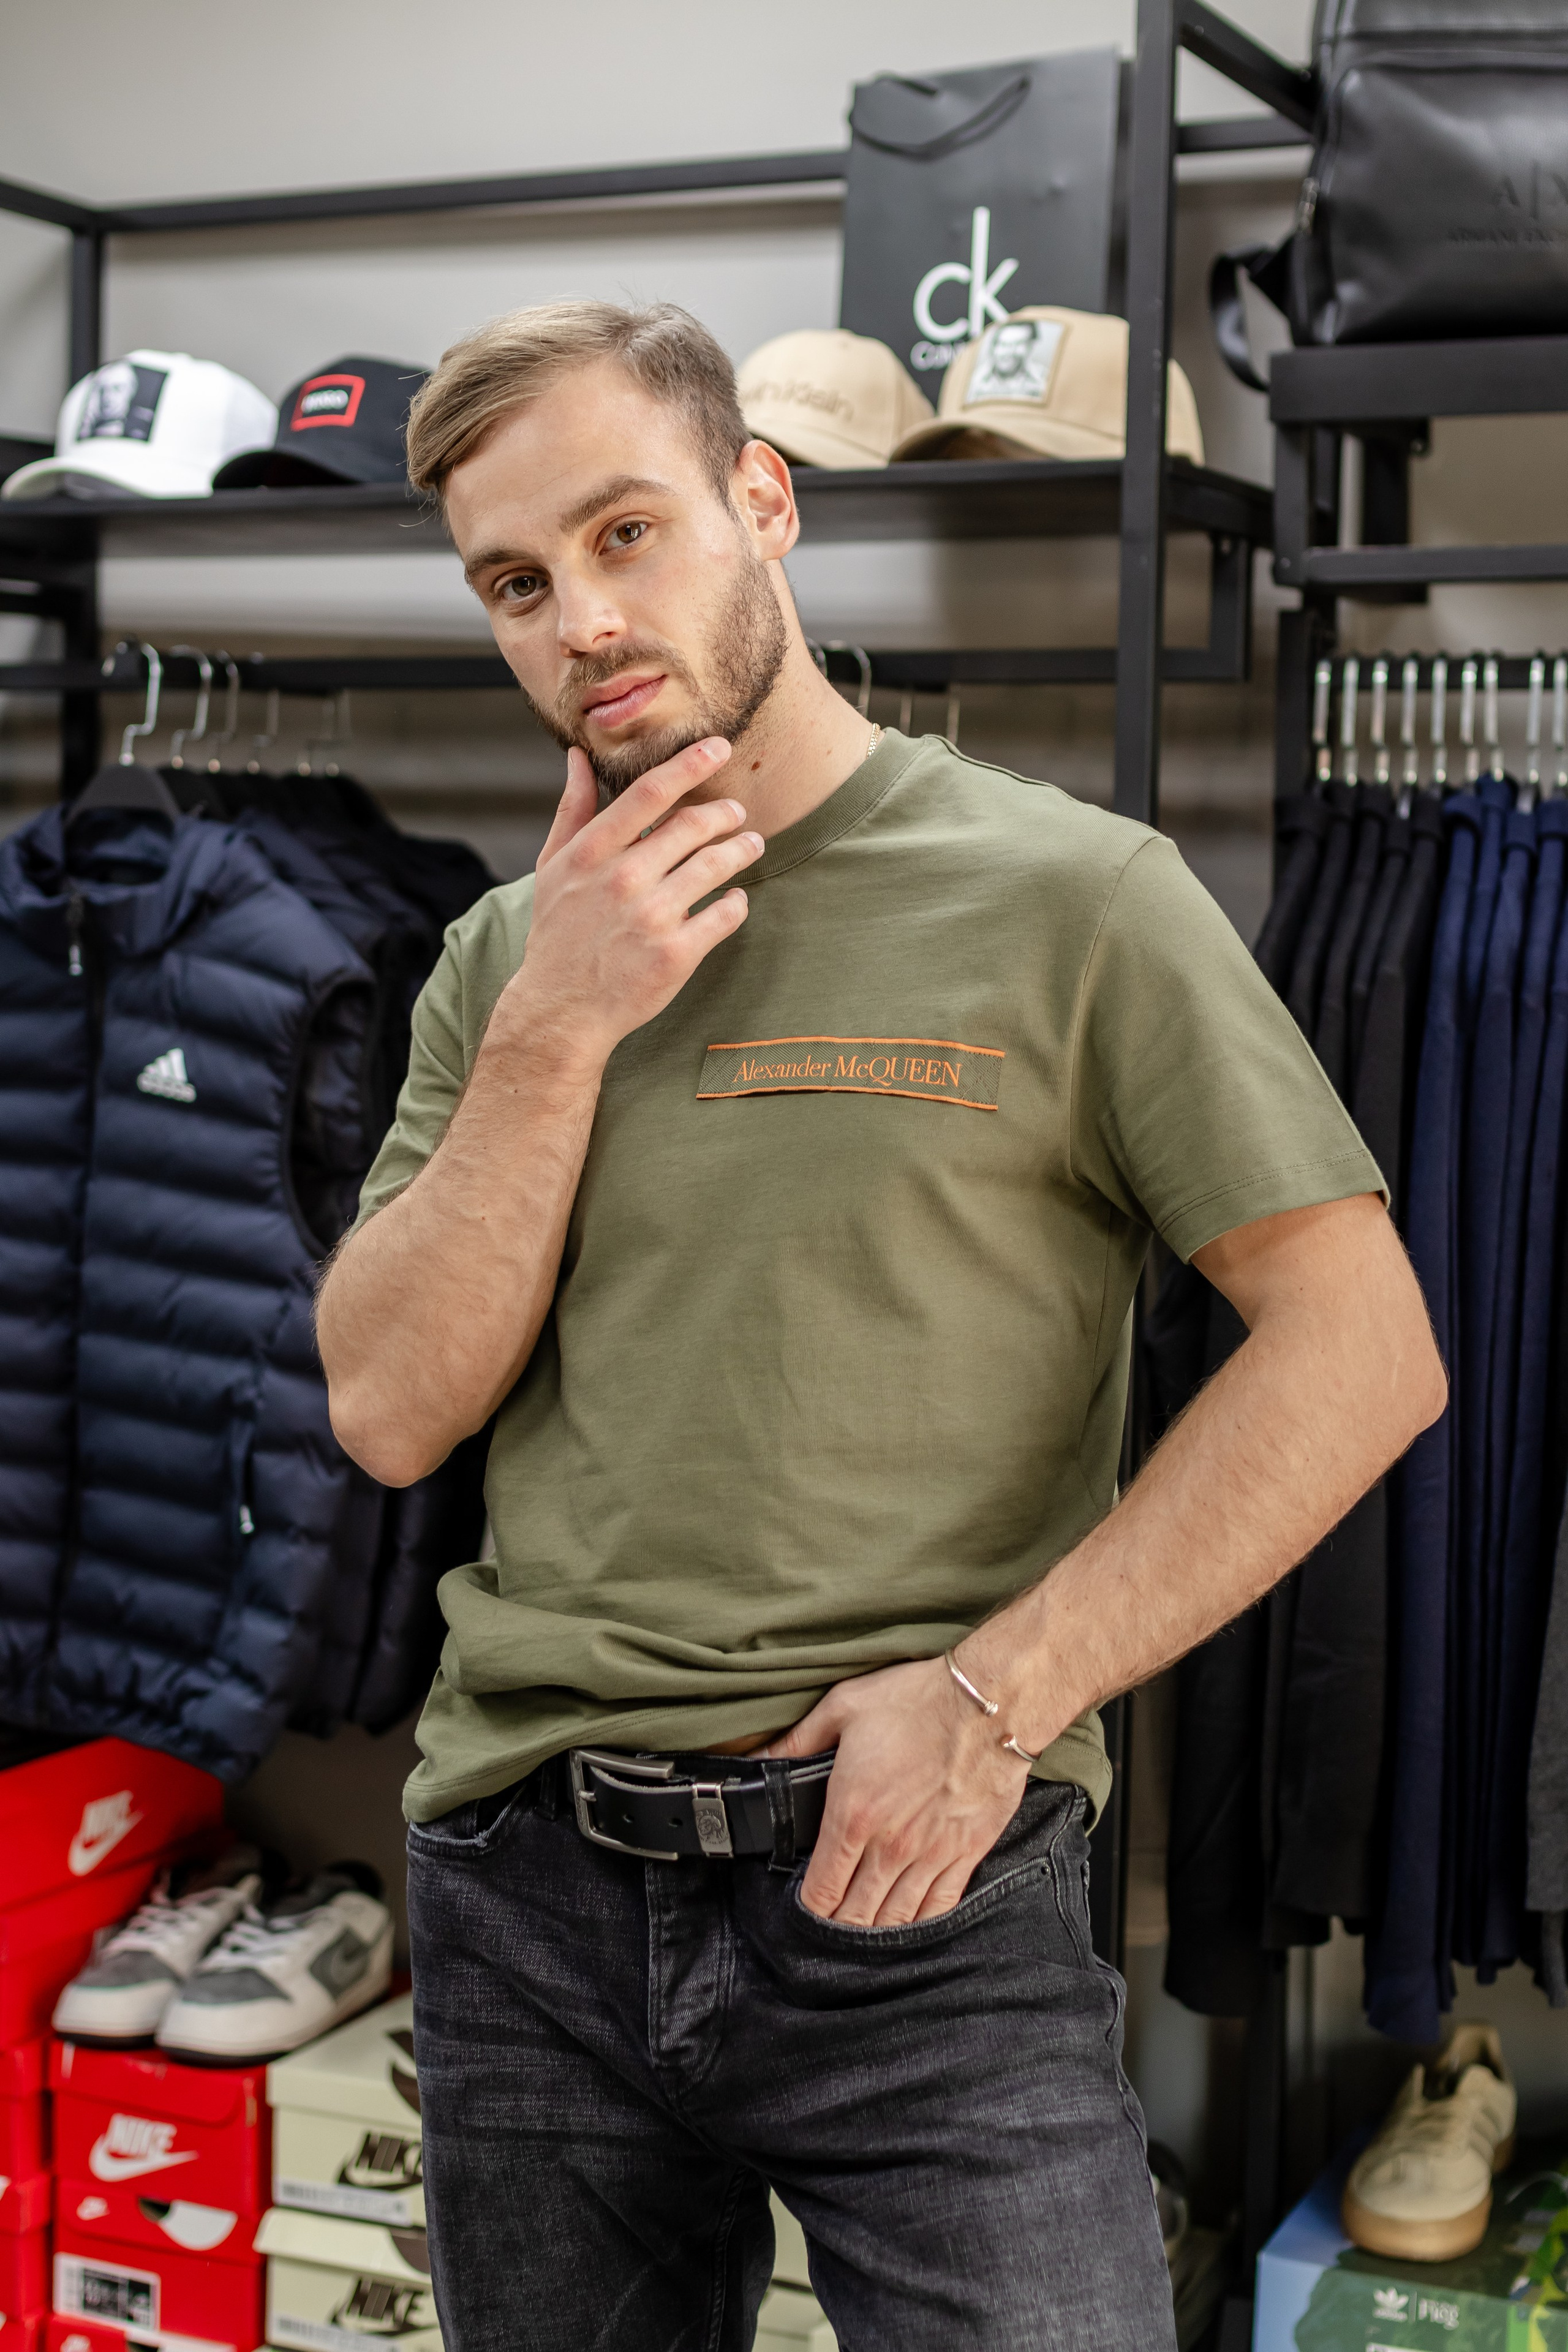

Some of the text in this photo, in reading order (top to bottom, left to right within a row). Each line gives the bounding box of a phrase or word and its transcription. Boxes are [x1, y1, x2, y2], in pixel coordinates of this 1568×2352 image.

[913, 206, 1019, 342] ck
[733, 1054, 962, 1087] Alexander McQUEEN
[107, 2113, 178, 2156] NIKE
[346, 2277, 424, 2326] NIKE
